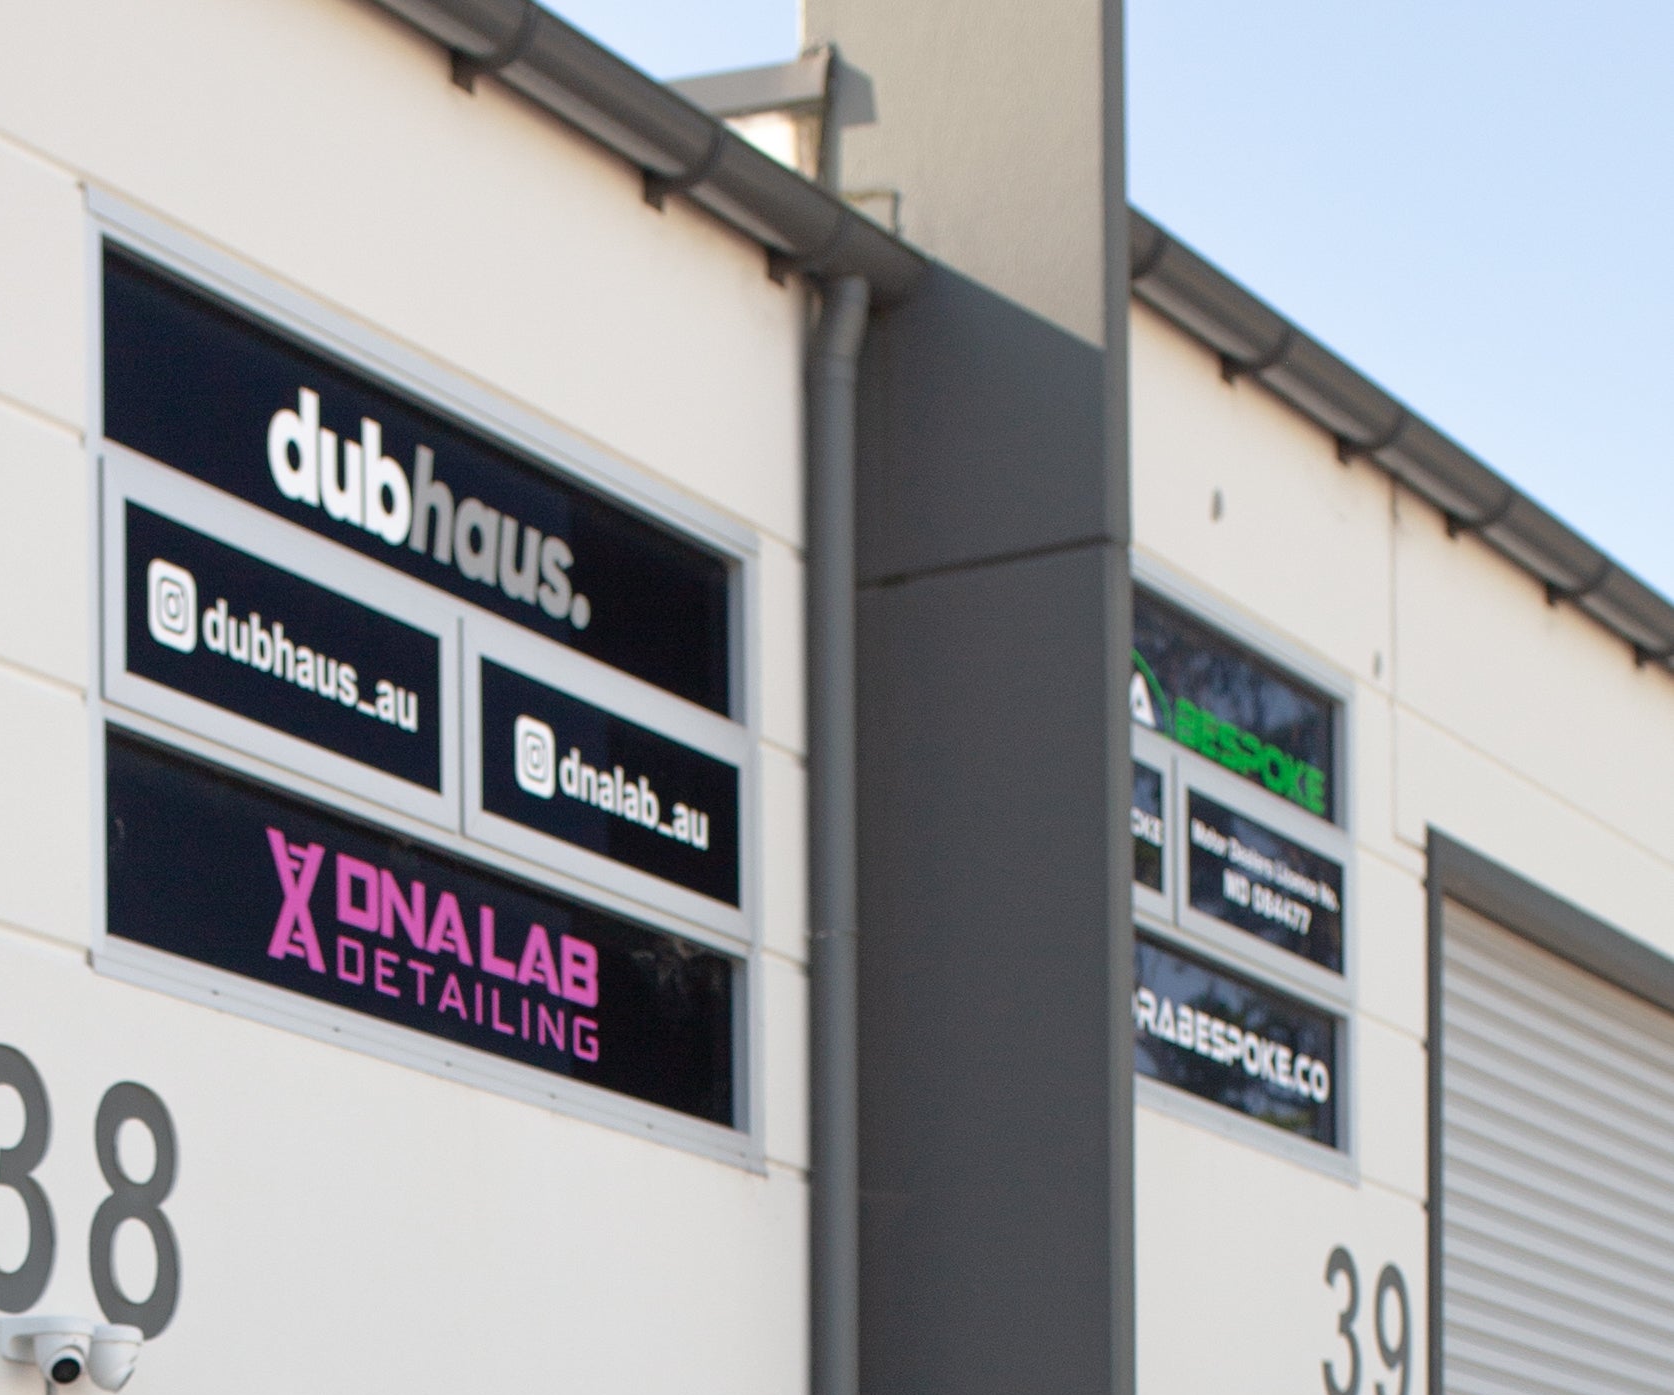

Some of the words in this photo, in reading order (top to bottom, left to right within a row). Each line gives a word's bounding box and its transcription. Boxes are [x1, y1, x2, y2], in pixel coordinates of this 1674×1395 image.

[267, 388, 591, 629] dubhaus.
[202, 599, 418, 732] dubhaus_au
[559, 748, 709, 850] dnalab_au
[1174, 697, 1325, 815] BESPOKE
[336, 935, 599, 1062] DETAILING
[1132, 985, 1329, 1104] RABESPOKE.CO
